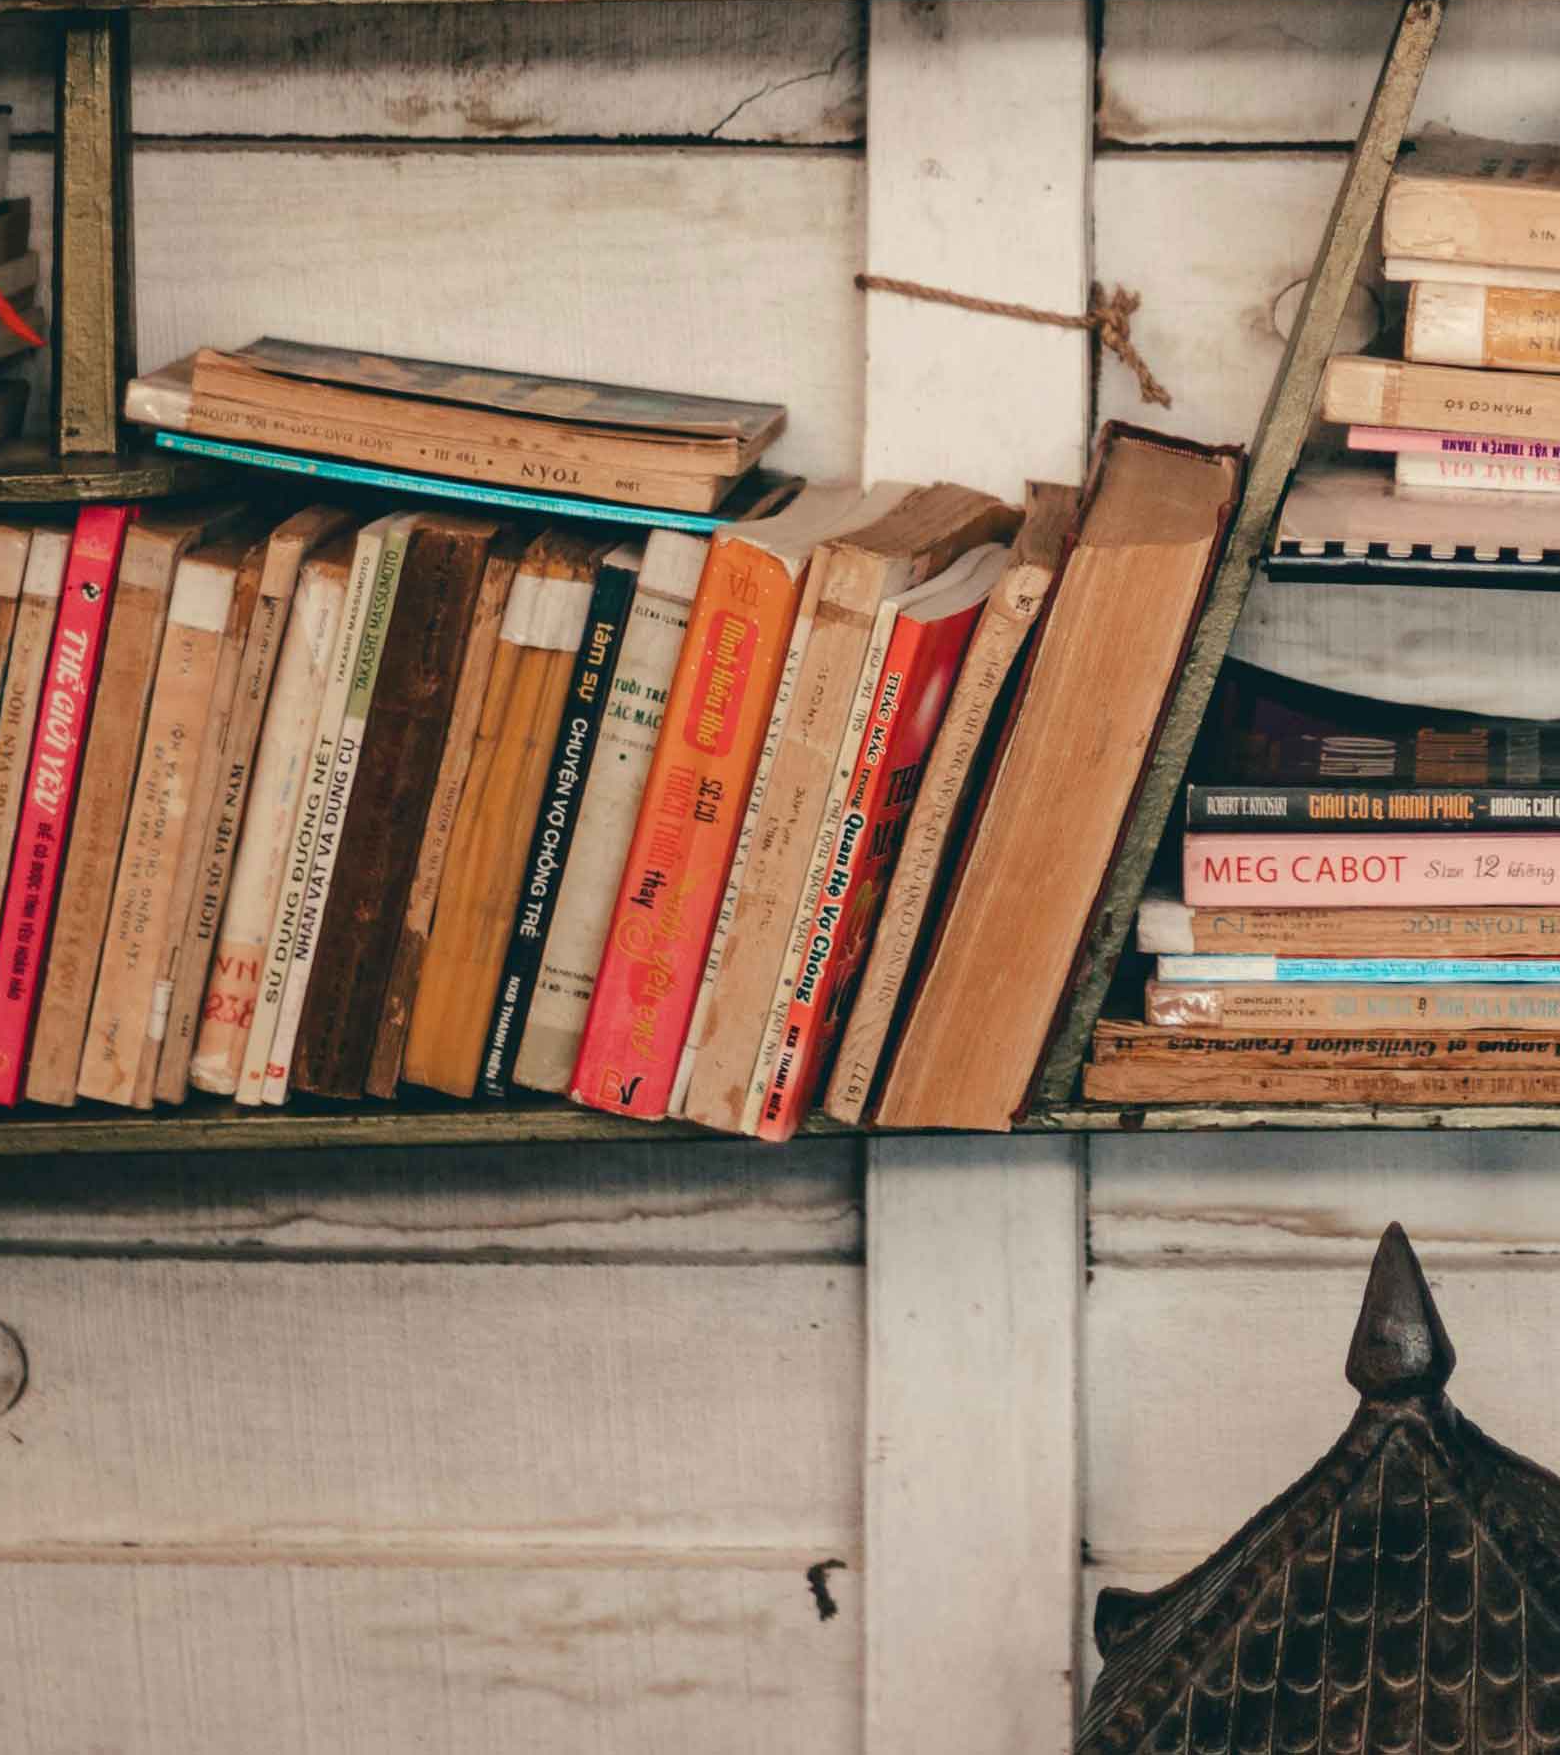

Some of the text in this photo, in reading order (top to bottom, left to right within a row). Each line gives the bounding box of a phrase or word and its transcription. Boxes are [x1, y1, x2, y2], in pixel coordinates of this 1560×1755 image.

[519, 460, 581, 487] TOÁN
[351, 547, 402, 692] TAKASHI MASSUMOTO
[874, 669, 904, 724] THẮC
[30, 626, 95, 817] THẾ GIỚI YÊU
[862, 724, 888, 766] MẮC
[518, 620, 614, 940] tâm sự CHUYỆN VỢ CHỒNG TRẺ
[846, 766, 871, 809] trong
[289, 736, 361, 961] NHÂN VẬT VÀ DỤNG CỤ
[832, 811, 866, 868] Quan
[260, 730, 334, 1004] SỬ DỤNG ĐƯỜNG NÉT
[629, 865, 669, 910] thay
[820, 865, 850, 898] Hệ
[1204, 856, 1407, 883] MEG CABOT
[1423, 857, 1463, 880] Size
[1473, 853, 1499, 880] 12
[1506, 859, 1553, 887] không
[810, 901, 840, 933] Vợ
[842, 1061, 871, 1105] 1977
